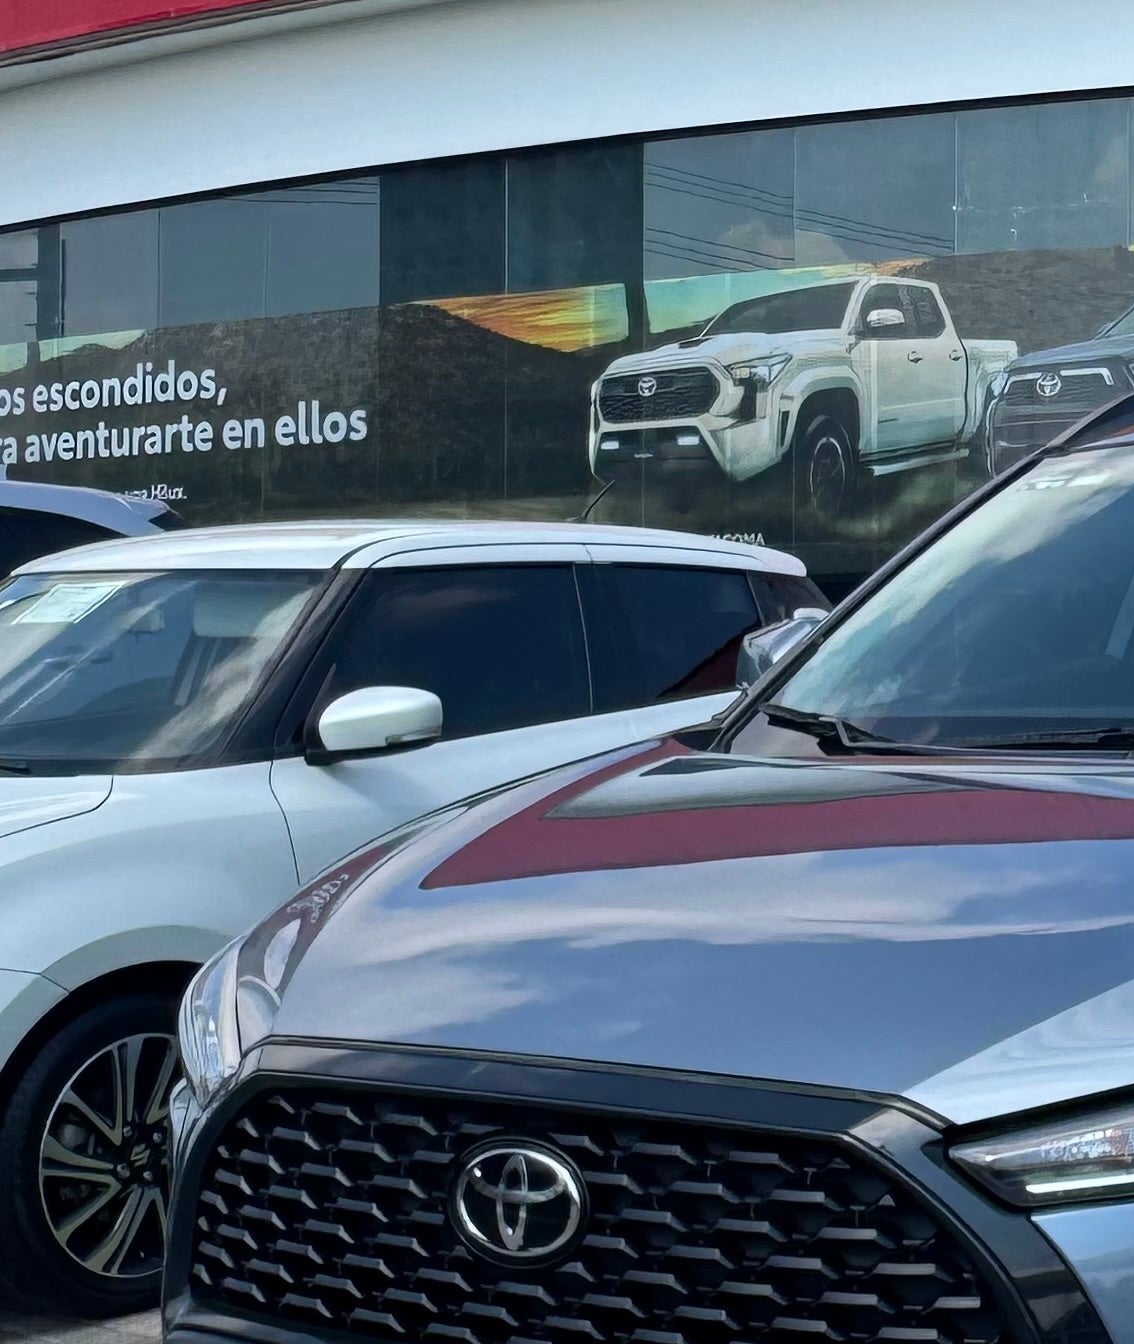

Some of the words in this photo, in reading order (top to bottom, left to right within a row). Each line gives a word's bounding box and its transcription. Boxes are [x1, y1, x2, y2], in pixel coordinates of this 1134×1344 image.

[32, 359, 227, 413] escondidos,
[24, 414, 213, 464] aventurarte
[222, 418, 265, 450] en
[274, 399, 368, 447] ellos
